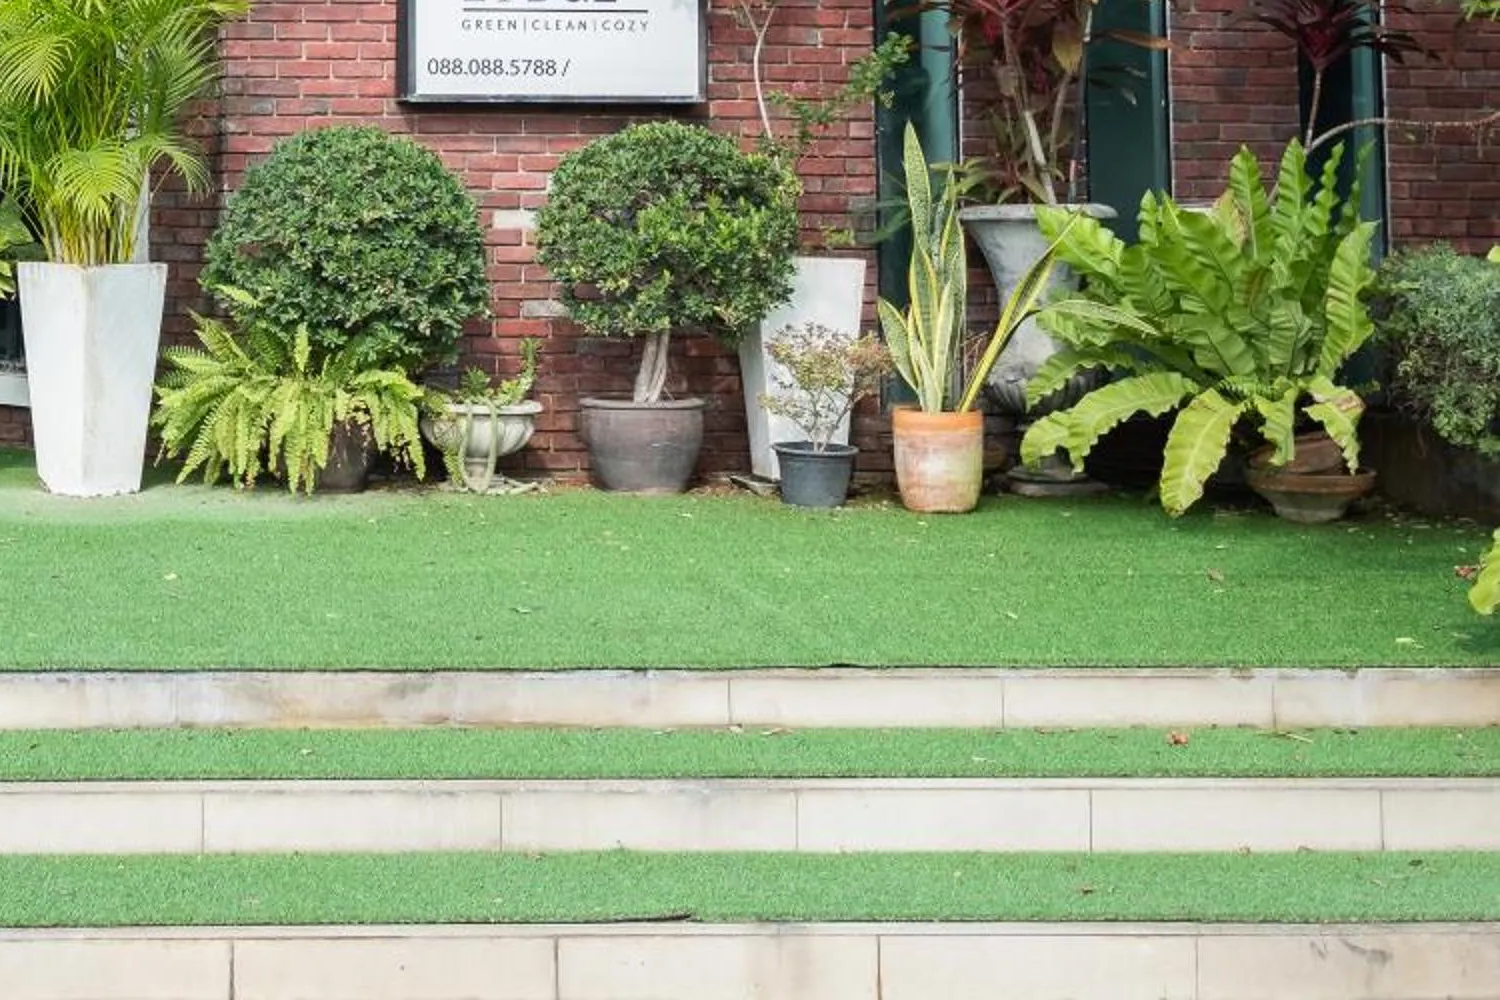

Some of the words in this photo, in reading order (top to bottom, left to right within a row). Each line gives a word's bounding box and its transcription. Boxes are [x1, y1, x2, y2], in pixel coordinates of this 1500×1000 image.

[461, 18, 518, 32] GREEN
[531, 18, 588, 32] CLEAN
[601, 19, 649, 33] COZY
